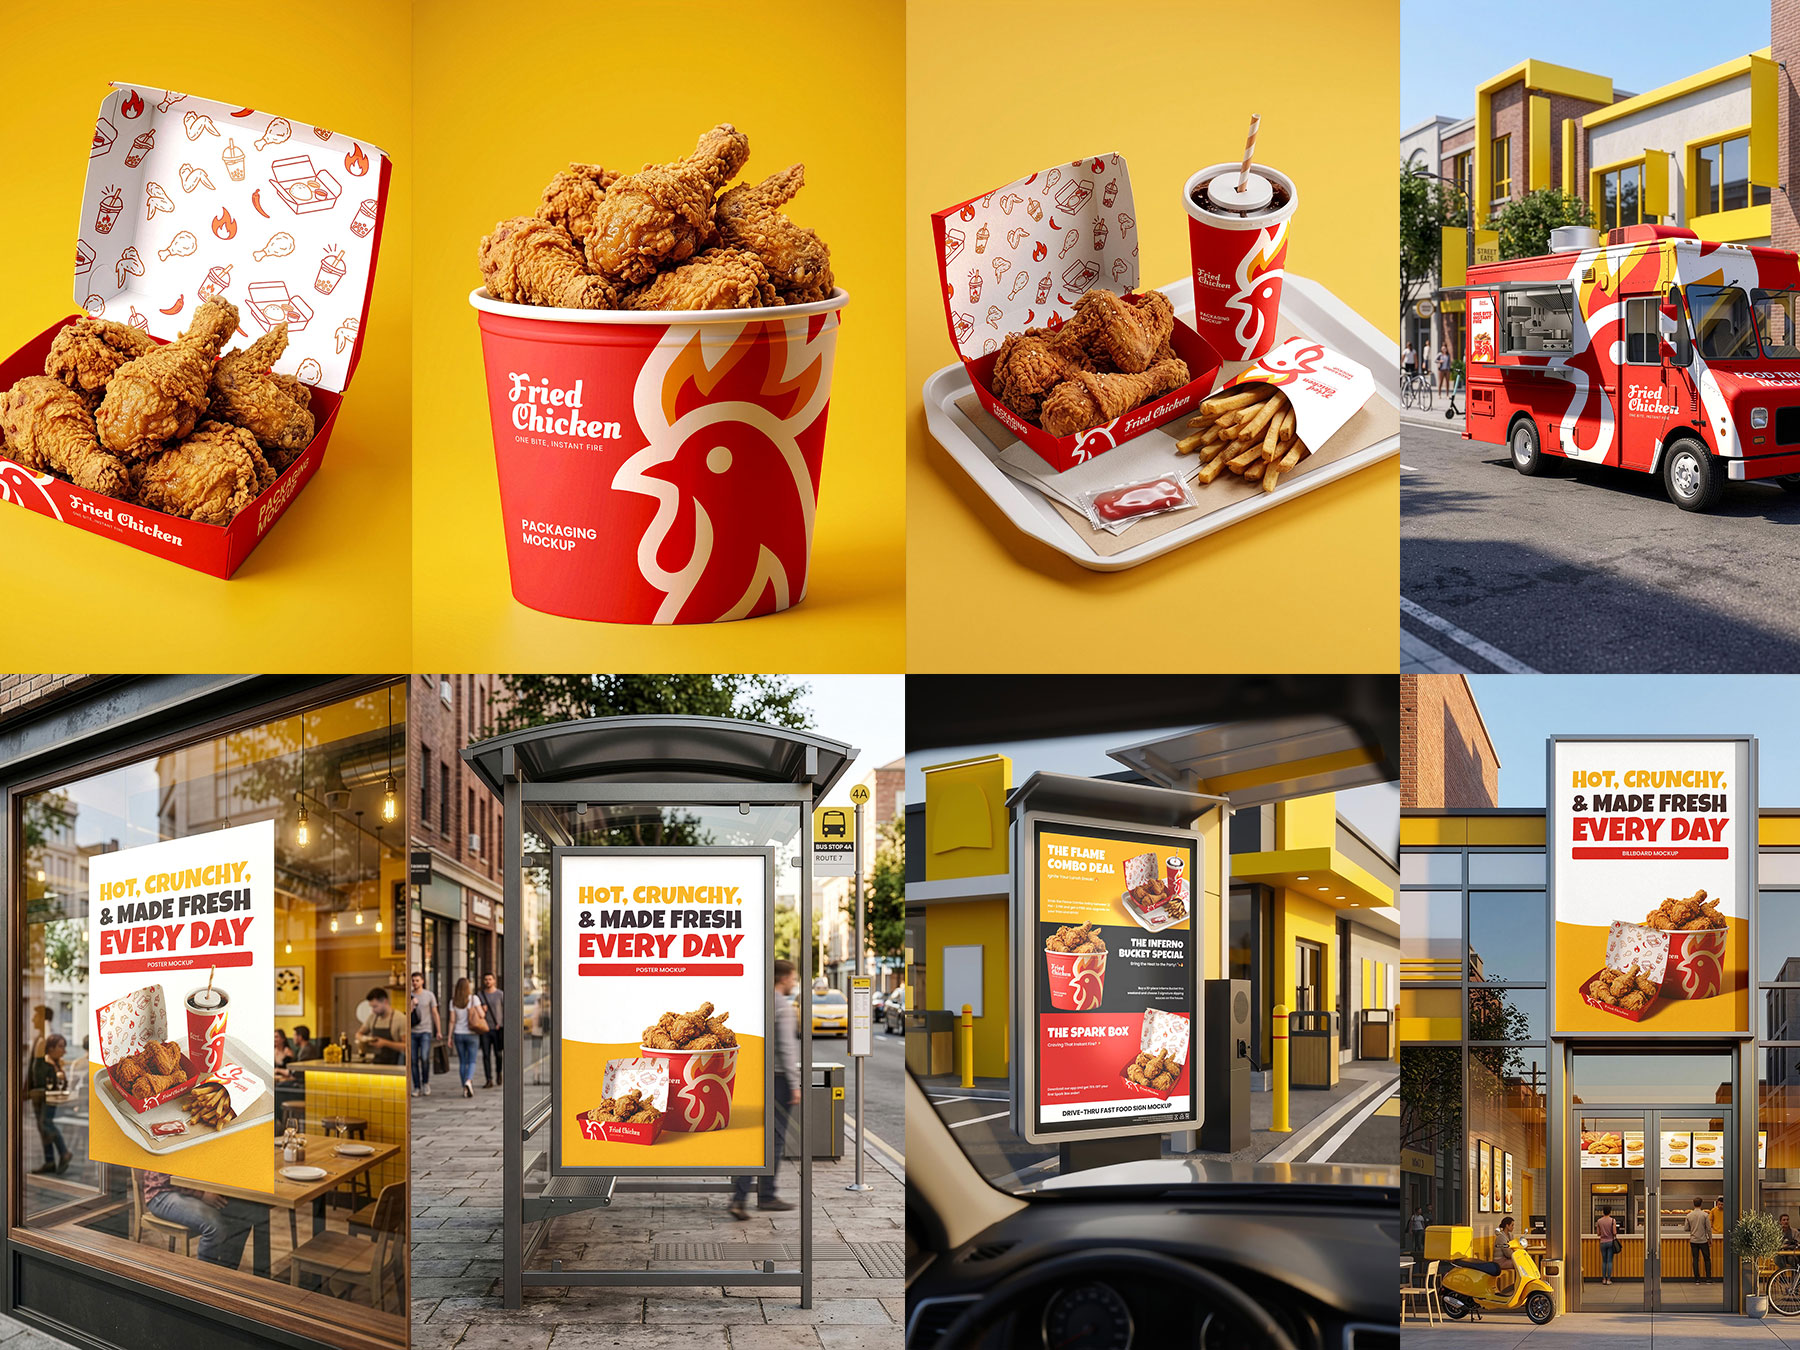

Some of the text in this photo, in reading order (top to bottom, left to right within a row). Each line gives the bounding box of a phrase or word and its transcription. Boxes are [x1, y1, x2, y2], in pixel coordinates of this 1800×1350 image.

[1197, 268, 1220, 280] Fried
[1199, 276, 1230, 288] Chicken
[508, 372, 583, 408] Fried
[1628, 384, 1662, 399] Fried
[1124, 411, 1152, 432] Fried
[1153, 396, 1190, 418] Chicken
[1629, 398, 1679, 415] Chicken
[512, 403, 622, 439] Chicken
[531, 438, 550, 448] BITE,
[551, 441, 584, 450] INSTANT
[586, 444, 603, 452] FIRE
[259, 457, 309, 521] PACKAGING
[257, 480, 297, 536] MOCKUP
[69, 494, 182, 546] Fried Chicken
[522, 519, 597, 540] PACKAGING
[523, 533, 575, 551] MOCKUP
[1572, 770, 1728, 790] HOT, CRUNCHY,
[852, 789, 867, 798] 4A
[1572, 794, 1727, 812] & MADE FRESH
[1572, 817, 1730, 842] EVERY DAY
[1048, 844, 1105, 860] THE FLAME
[1048, 858, 1115, 874] COMBO DEAL
[100, 861, 251, 901] HOT, CRUNCHY,
[578, 886, 742, 906] HOT, CRUNCHY,
[100, 888, 251, 925] & MADE FRESH
[578, 910, 742, 929] & MADE FRESH
[100, 917, 254, 955] EVERY DAY
[1131, 938, 1184, 948] THE INFERNO
[579, 933, 745, 958] EVERY DAY
[1119, 948, 1184, 959] BUCKET SPECIAL
[168, 959, 194, 967] MOCKUP
[1047, 1026, 1129, 1038] THE SPARK BOX
[1062, 1108, 1099, 1116] DRIVE-THRU
